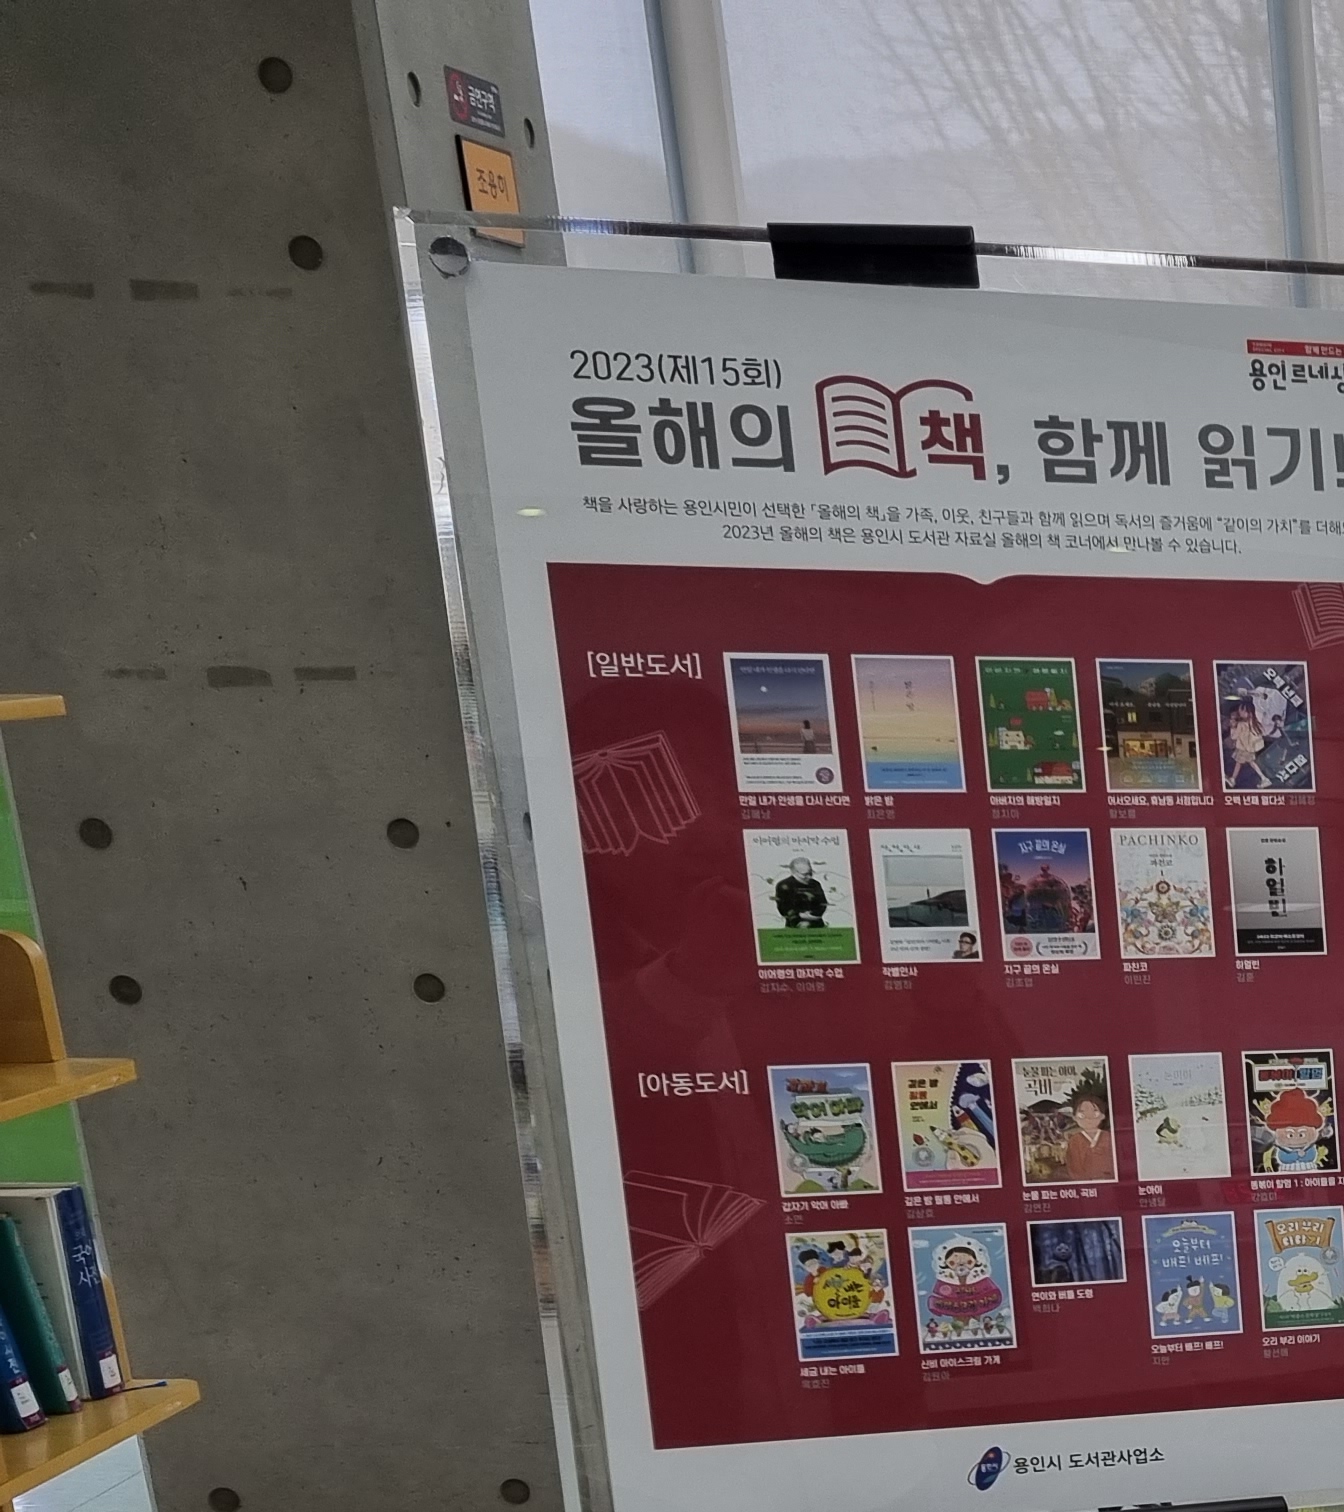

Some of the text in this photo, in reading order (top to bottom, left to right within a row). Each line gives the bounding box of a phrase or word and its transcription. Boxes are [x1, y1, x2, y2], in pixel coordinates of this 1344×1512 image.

[467, 85, 496, 113] 금연구역
[570, 350, 782, 389] 2023(제15회)
[1249, 359, 1287, 391] 용인
[571, 396, 796, 473] 올해의
[1034, 414, 1171, 486] 함께
[582, 496, 613, 514] 책을
[617, 496, 678, 517] 사랑하는
[683, 498, 757, 518] 용인시민이
[762, 500, 806, 520] 선택한
[906, 505, 938, 525] 가족,
[942, 506, 975, 526] 이웃,
[978, 507, 1034, 526] 친구들과
[1038, 509, 1066, 528] 함께
[1069, 510, 1110, 529] 읽으며
[1114, 512, 1156, 531] 독서의
[1159, 514, 1213, 533] 즐거움에
[722, 523, 1242, 555] 2023년 올해의 책은 용인시 도서관 자료실 올해의 책 코너에서 만나볼 수 있습니다.
[586, 650, 703, 679] [일반도서]
[1119, 834, 1199, 847] PACHINKO
[638, 1070, 749, 1098] [아동도서]
[1013, 1447, 1165, 1474] 용인시 도서관사업소
